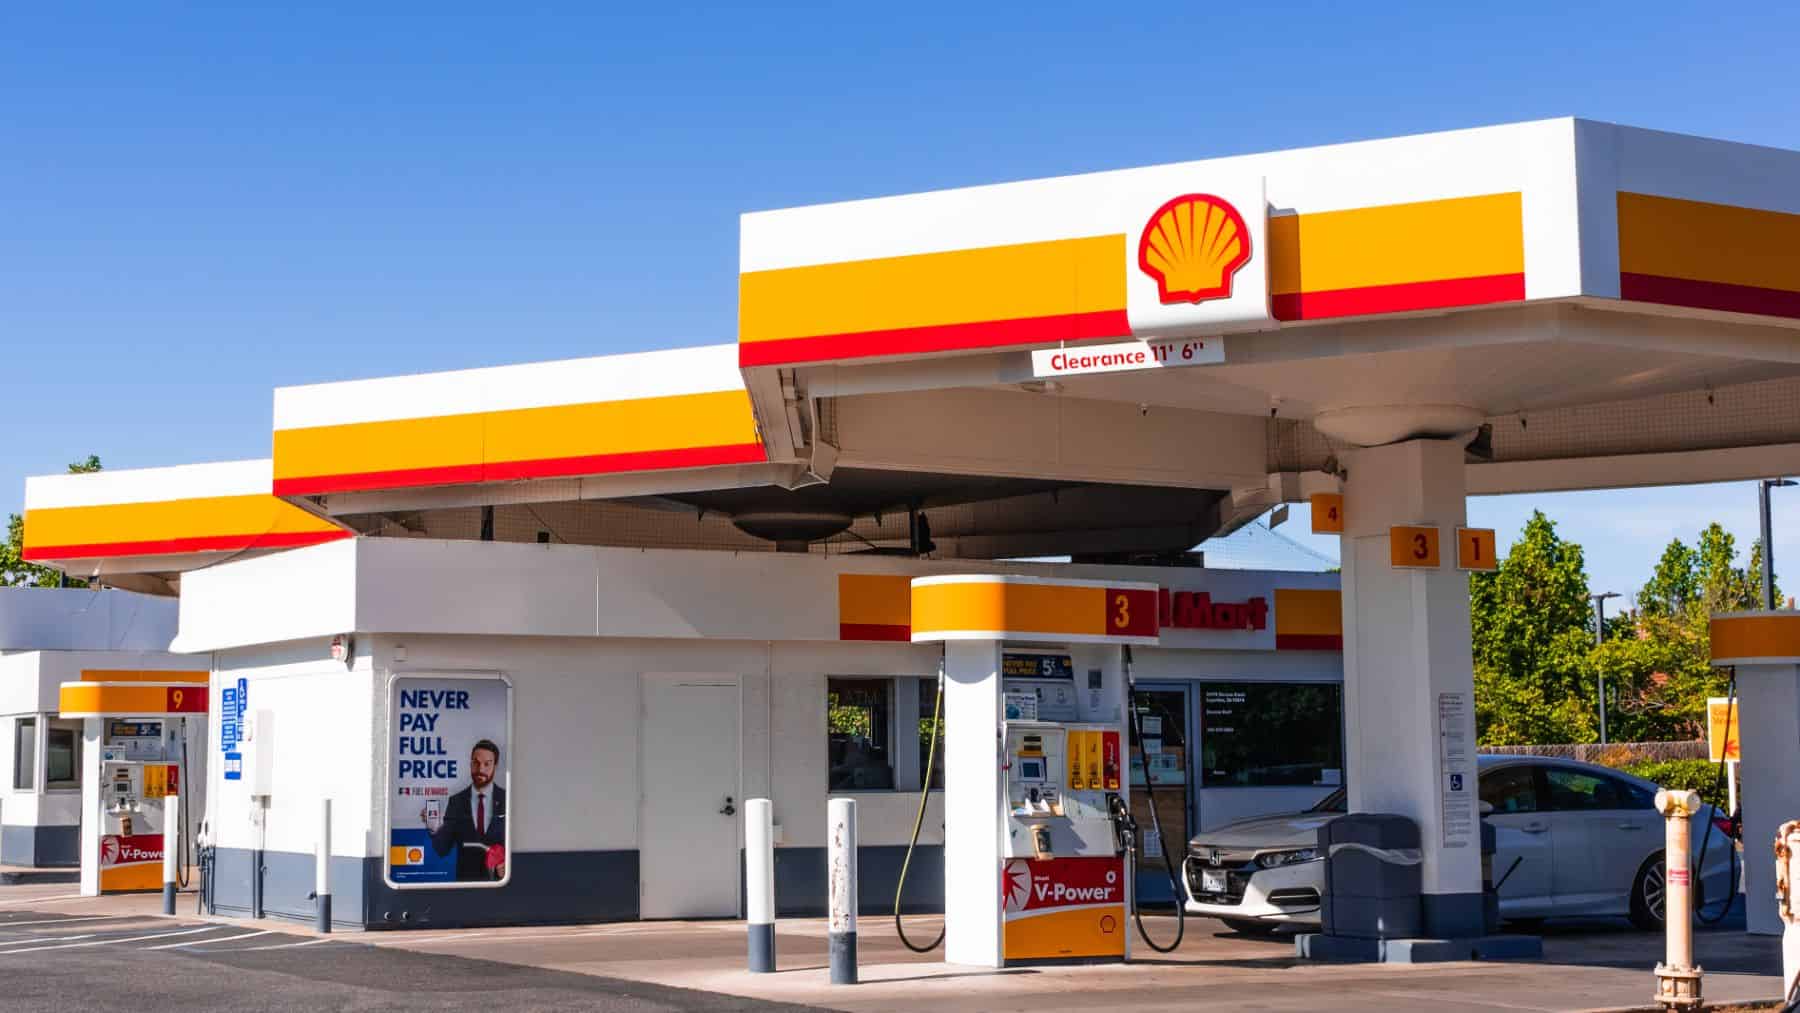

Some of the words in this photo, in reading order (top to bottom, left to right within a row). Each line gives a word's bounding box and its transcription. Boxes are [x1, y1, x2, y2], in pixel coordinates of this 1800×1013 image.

[1051, 352, 1145, 371] Clearance
[1152, 344, 1175, 362] 11'
[1328, 507, 1338, 521] 4
[1413, 534, 1428, 559] 3
[1471, 537, 1480, 560] 1
[1115, 595, 1129, 627] 3
[1173, 591, 1269, 631] Mart
[173, 690, 183, 708] 9
[400, 690, 469, 709] NEVER
[399, 713, 440, 732] PAY
[399, 736, 447, 754] FULL
[398, 760, 458, 779] PRICE
[121, 848, 164, 859] V-Powe
[1034, 883, 1110, 901] V-Power
